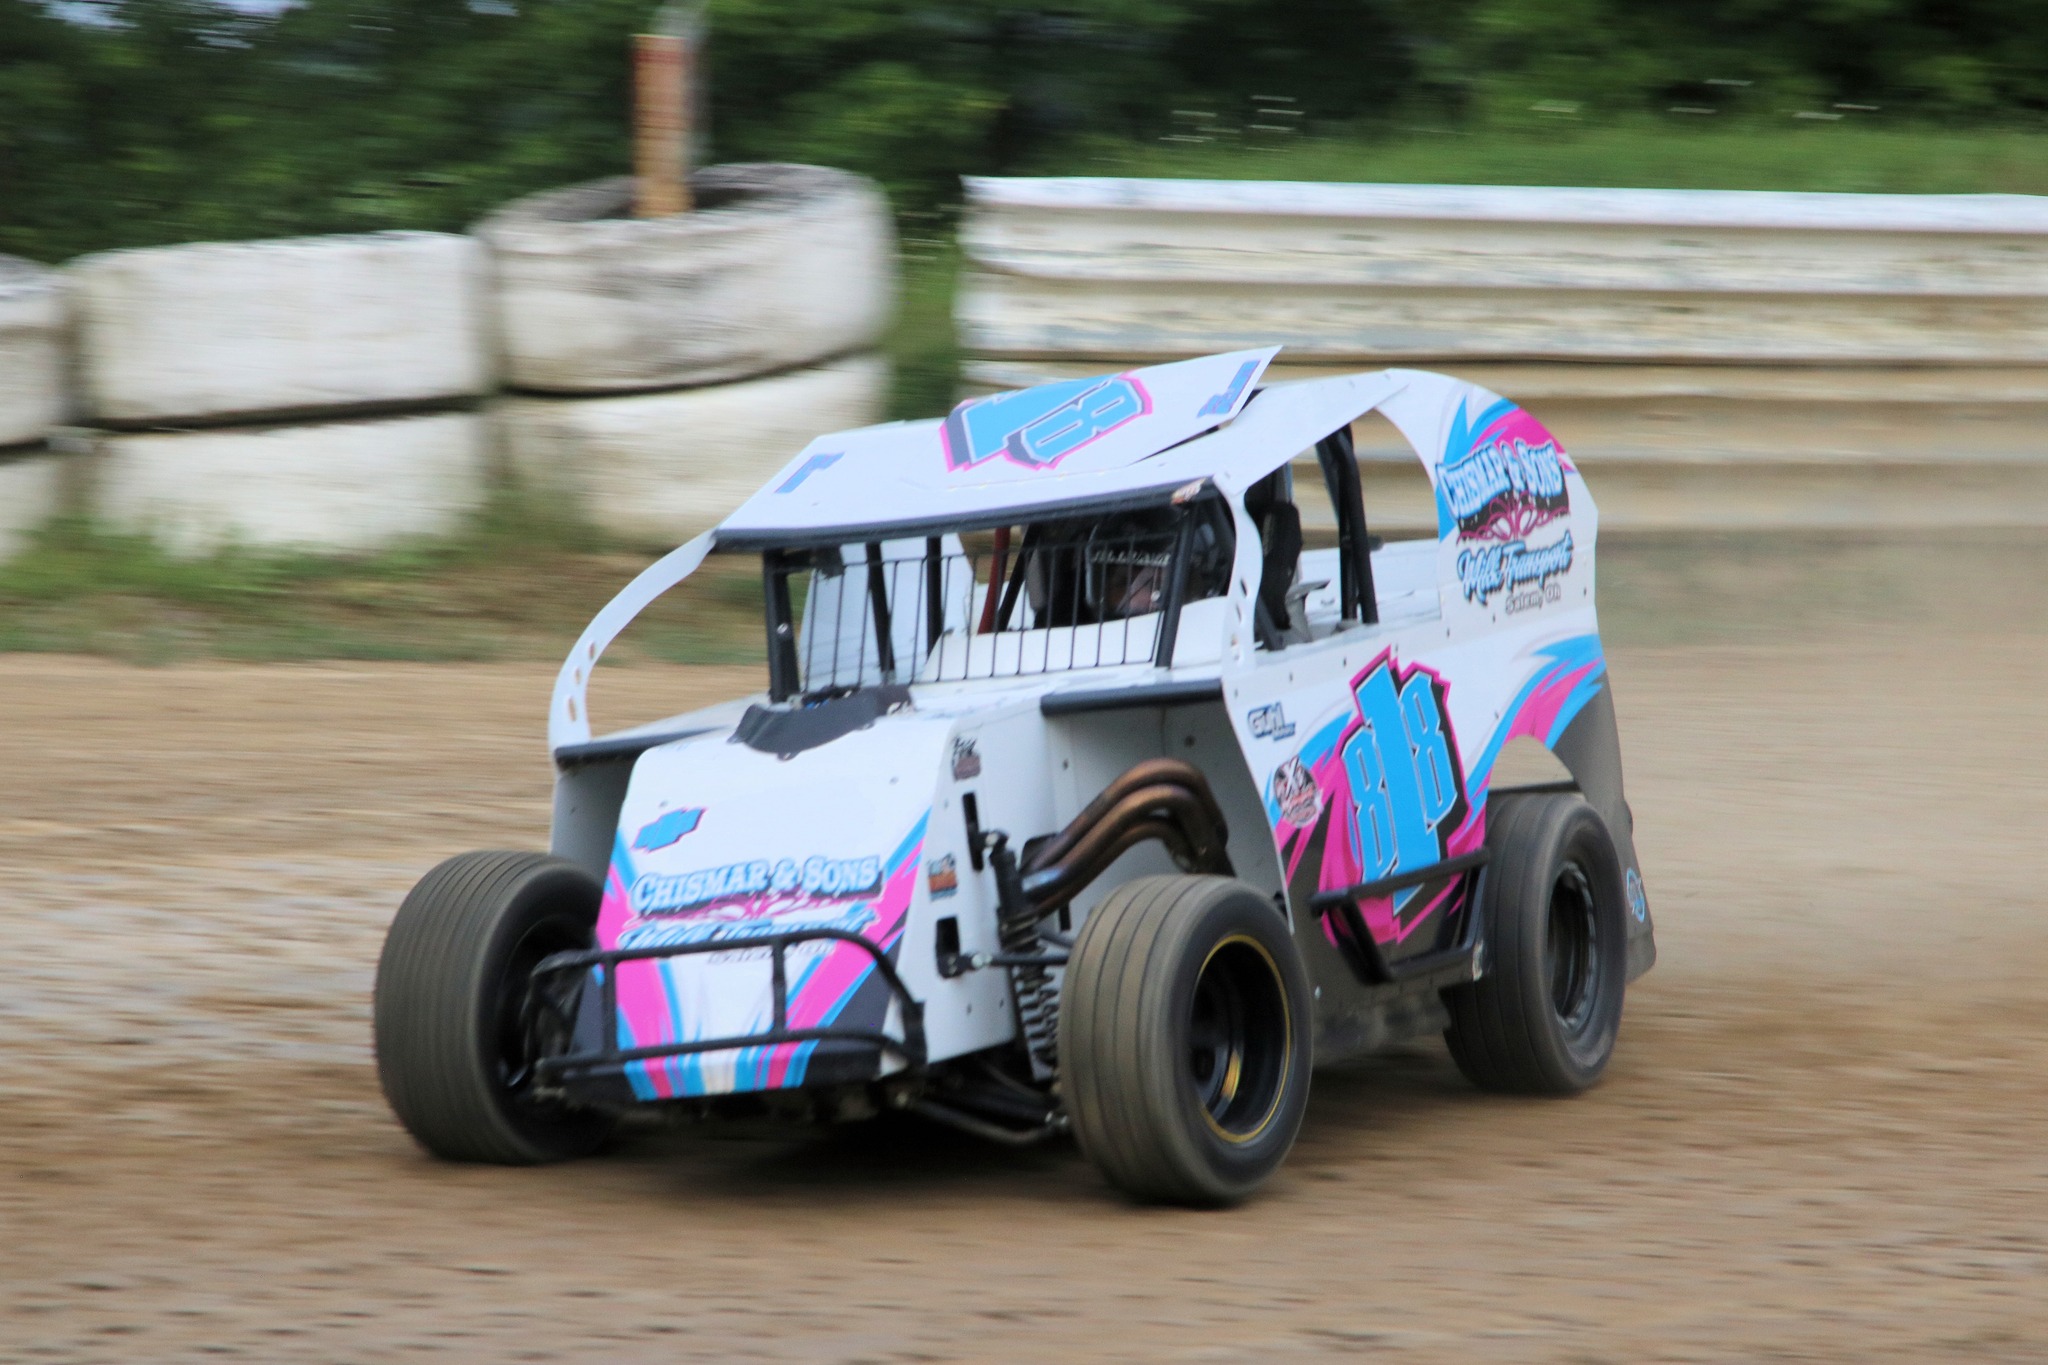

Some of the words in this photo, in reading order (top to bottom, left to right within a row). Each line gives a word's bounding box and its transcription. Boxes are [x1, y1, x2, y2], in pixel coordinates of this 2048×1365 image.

[1500, 441, 1525, 493] &
[1515, 439, 1564, 498] SONS
[630, 861, 770, 912] CHISMAR
[771, 857, 801, 891] &
[802, 855, 883, 899] SONS
